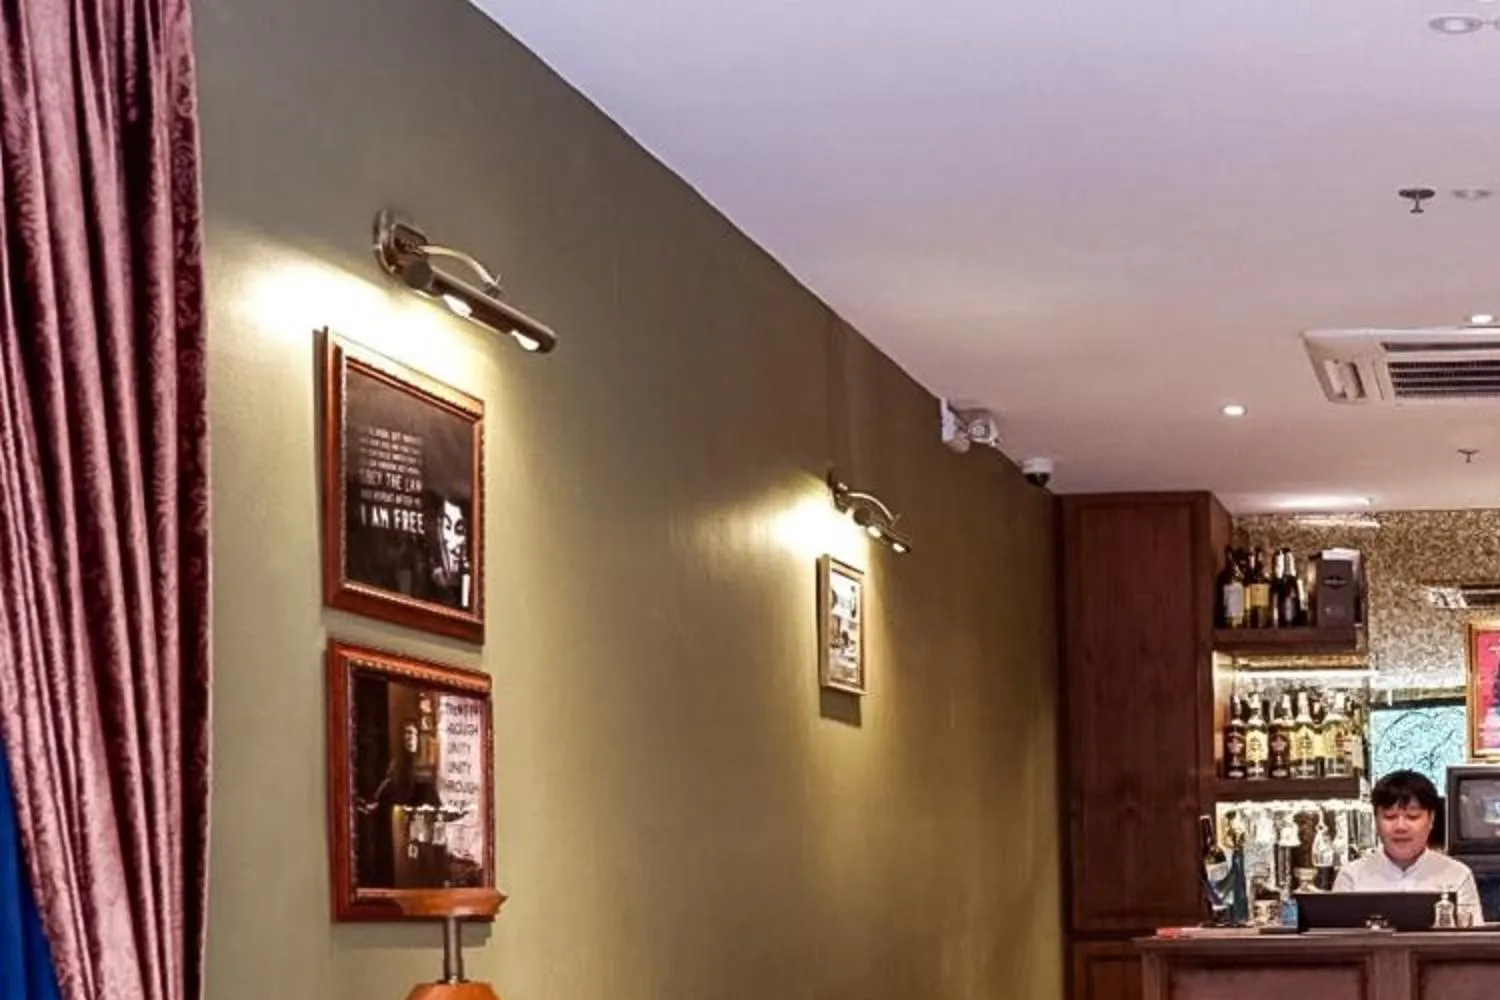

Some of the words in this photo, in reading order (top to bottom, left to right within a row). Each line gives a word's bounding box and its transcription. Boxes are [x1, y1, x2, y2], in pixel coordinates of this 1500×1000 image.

[361, 503, 367, 526] I
[372, 505, 389, 529] AM
[393, 508, 425, 535] FREE
